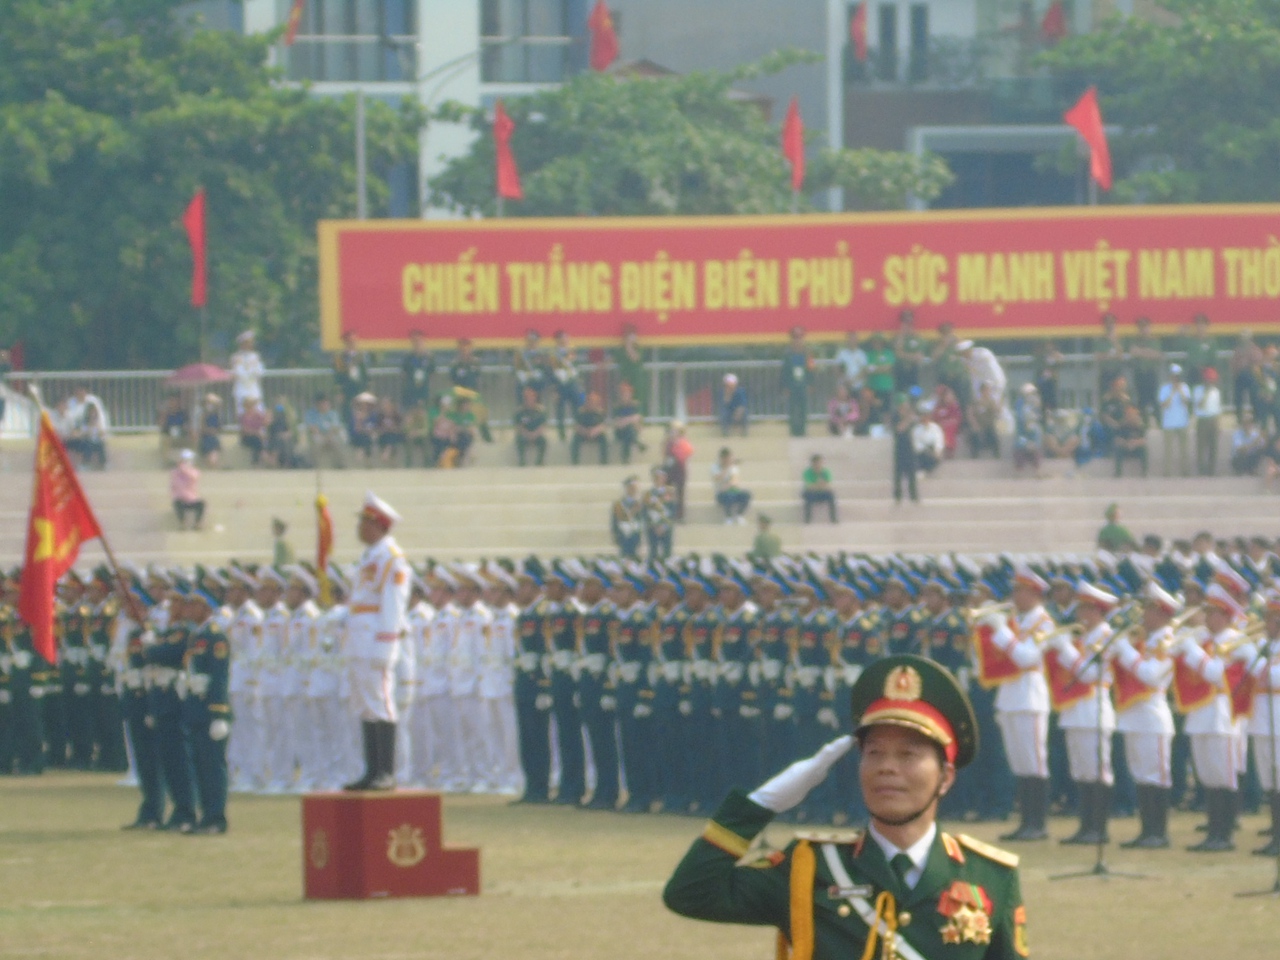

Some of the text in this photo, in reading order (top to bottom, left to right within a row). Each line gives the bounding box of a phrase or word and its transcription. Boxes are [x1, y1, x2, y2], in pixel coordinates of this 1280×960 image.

[403, 246, 498, 313] CHIẾN
[506, 243, 612, 312] THẮNG
[619, 250, 696, 322] ĐIỆN
[705, 249, 780, 309] BIÊN
[788, 240, 852, 308] PHỦ
[883, 244, 948, 304] SỨC
[957, 251, 1054, 315] MẠNH
[1062, 239, 1131, 312] VIỆT
[1138, 248, 1214, 298] NAM
